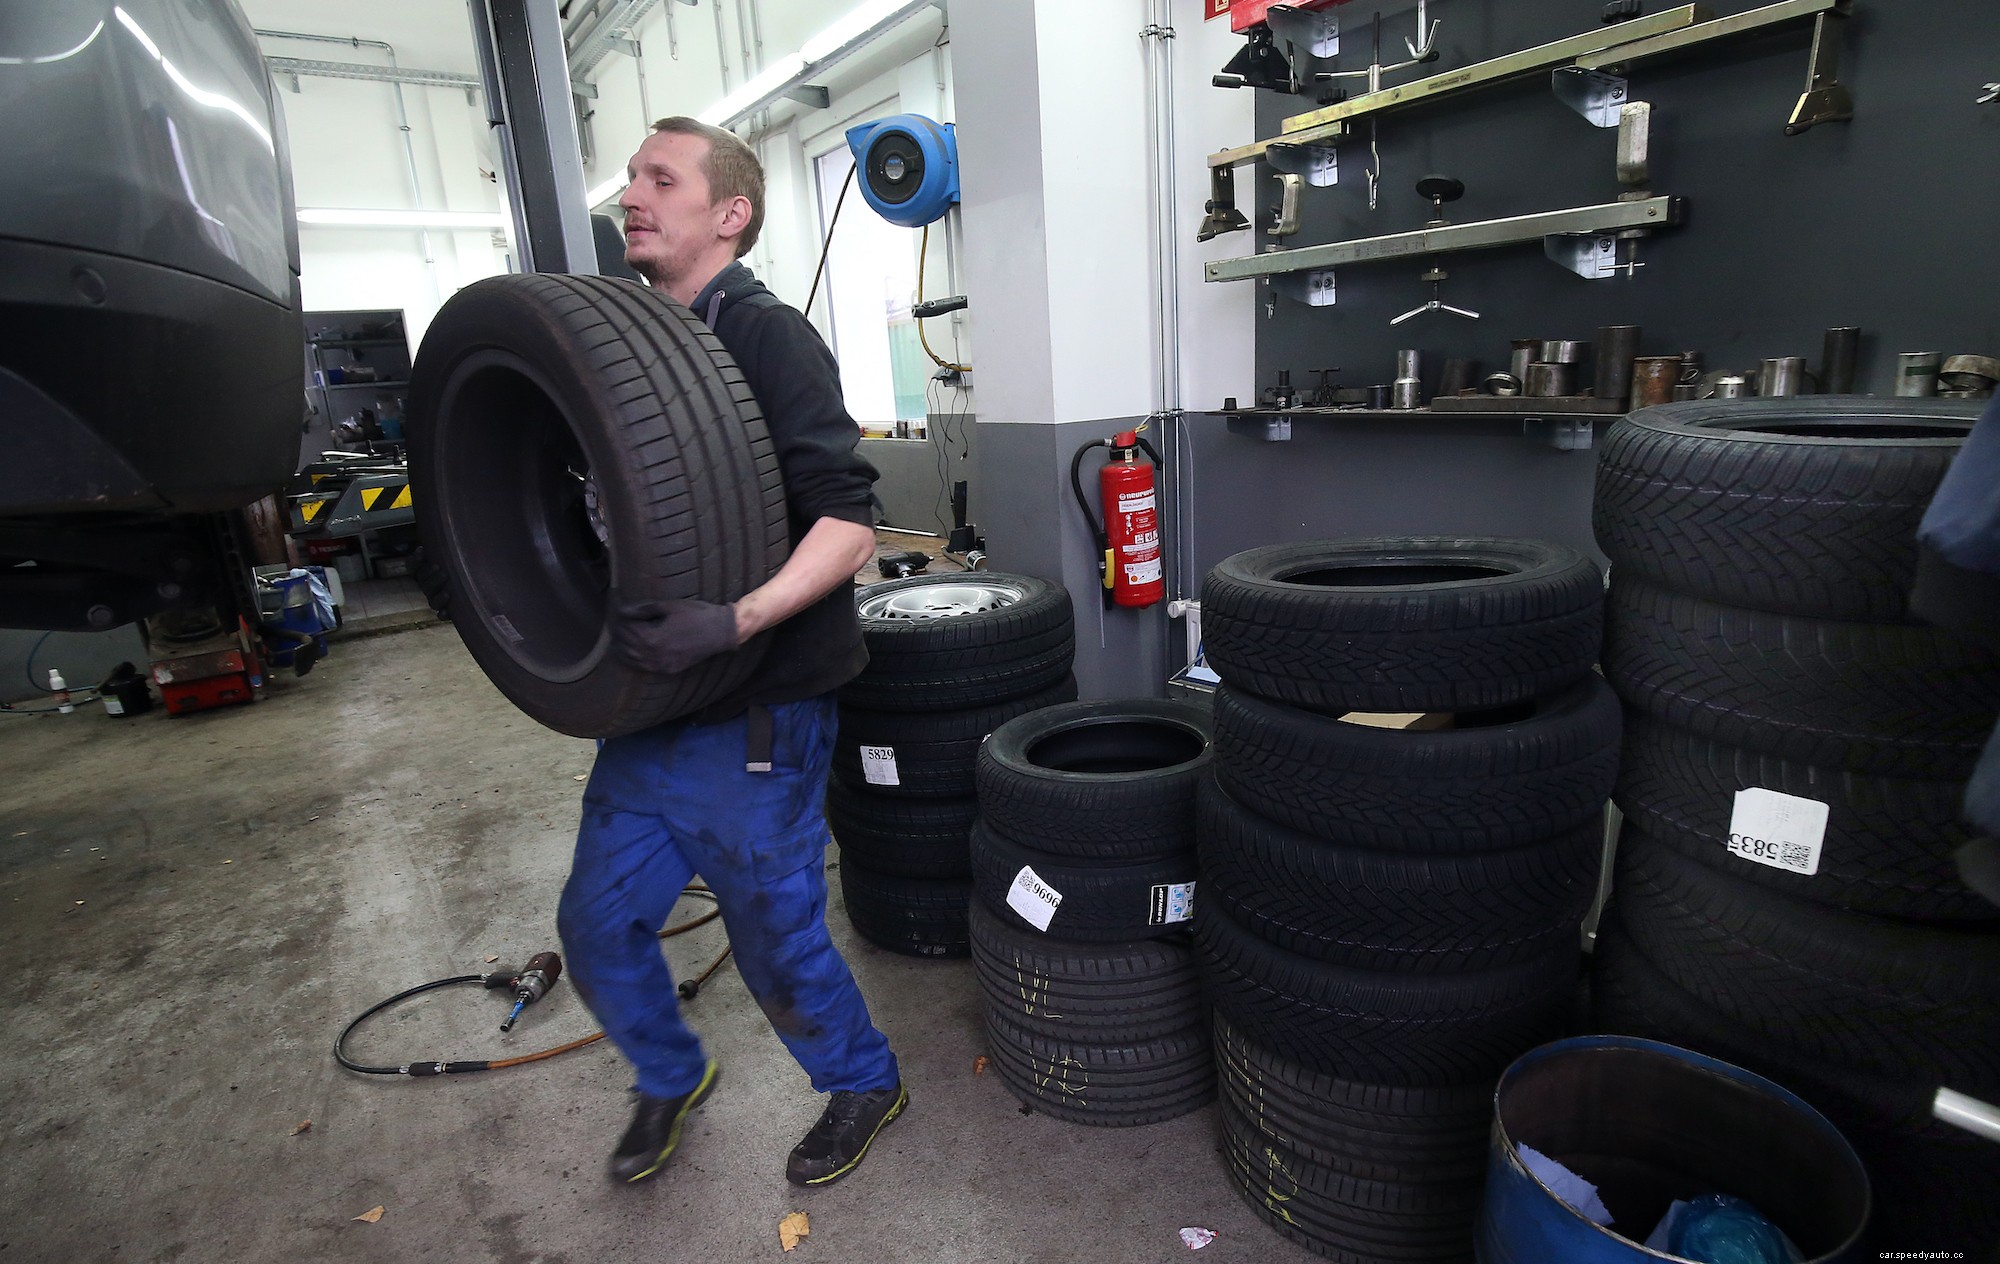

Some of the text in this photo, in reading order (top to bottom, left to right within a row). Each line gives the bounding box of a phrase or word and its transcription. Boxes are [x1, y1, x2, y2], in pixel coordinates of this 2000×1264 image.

[868, 748, 894, 760] 5829
[1728, 833, 1779, 860] 5835
[1032, 883, 1061, 908] 9696
